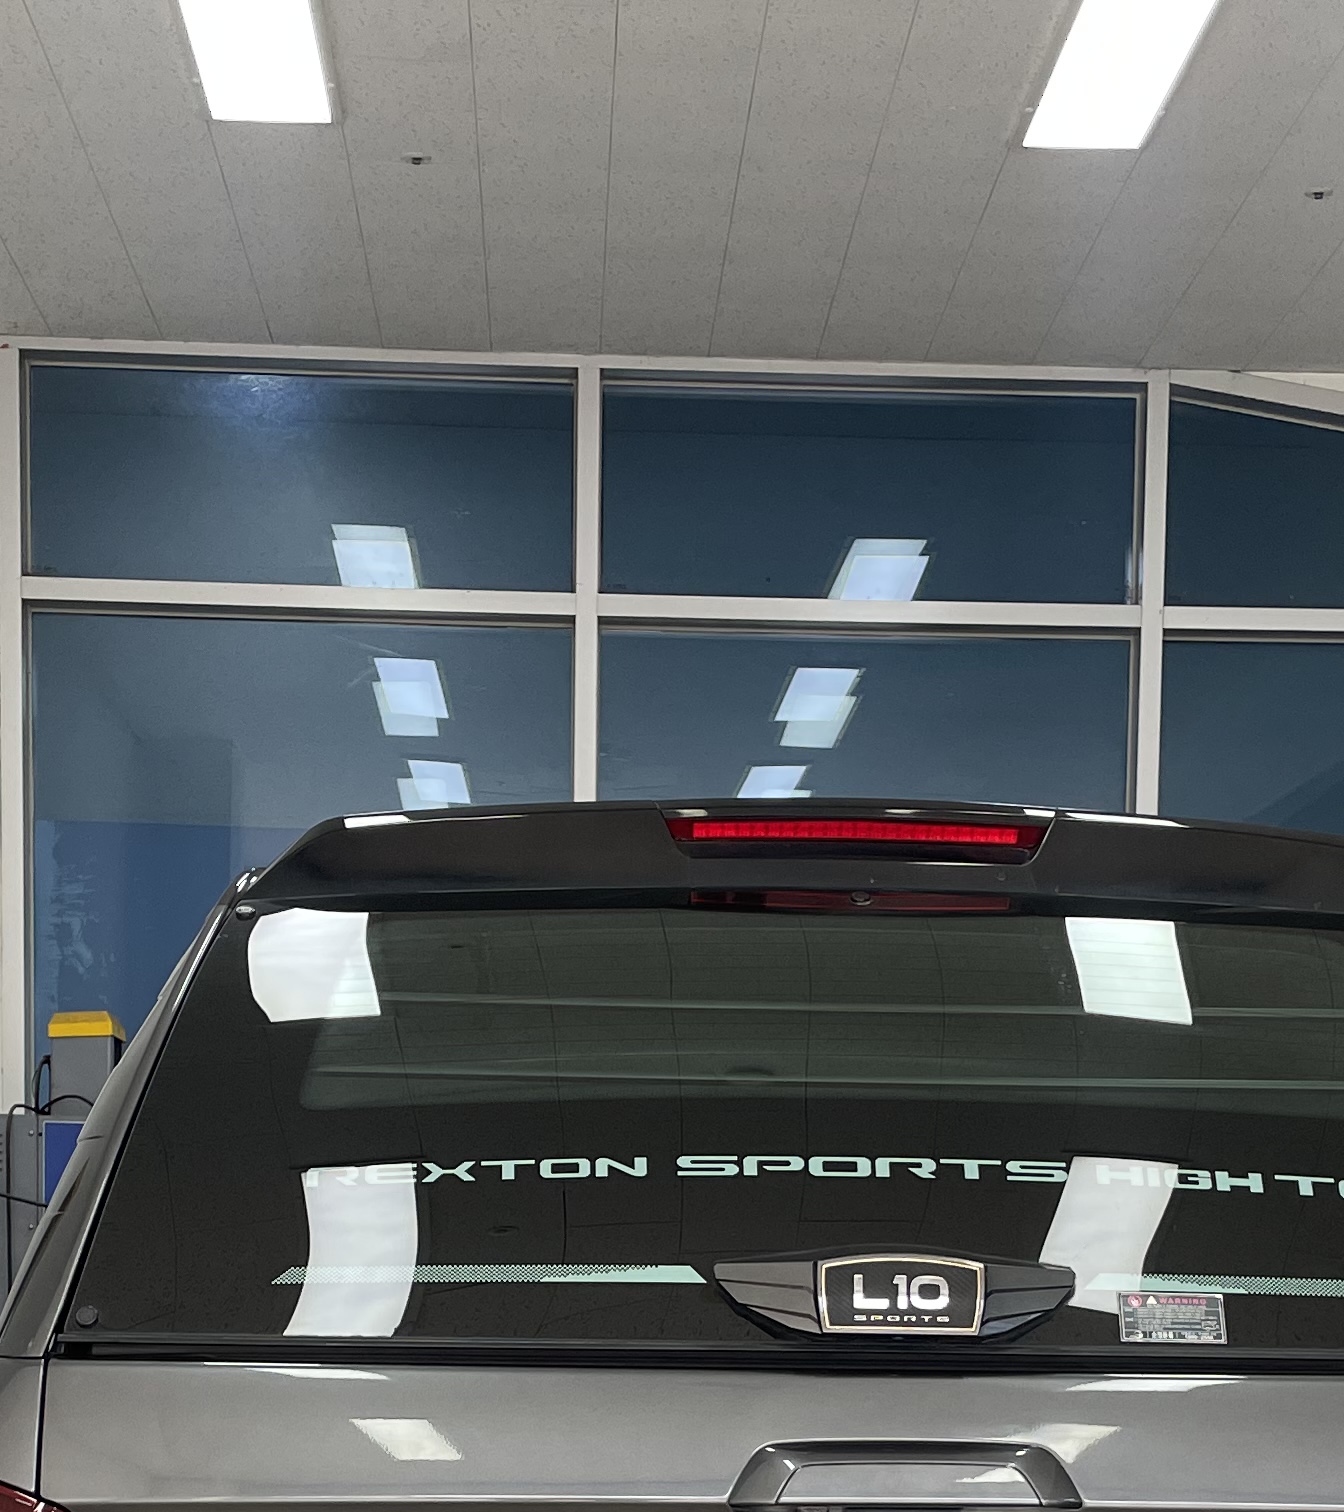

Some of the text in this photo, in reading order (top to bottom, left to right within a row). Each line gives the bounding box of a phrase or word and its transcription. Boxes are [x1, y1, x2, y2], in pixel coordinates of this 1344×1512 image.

[676, 1155, 1069, 1183] SPORTS
[853, 1273, 950, 1310] L10
[853, 1314, 950, 1323] SPORTS
